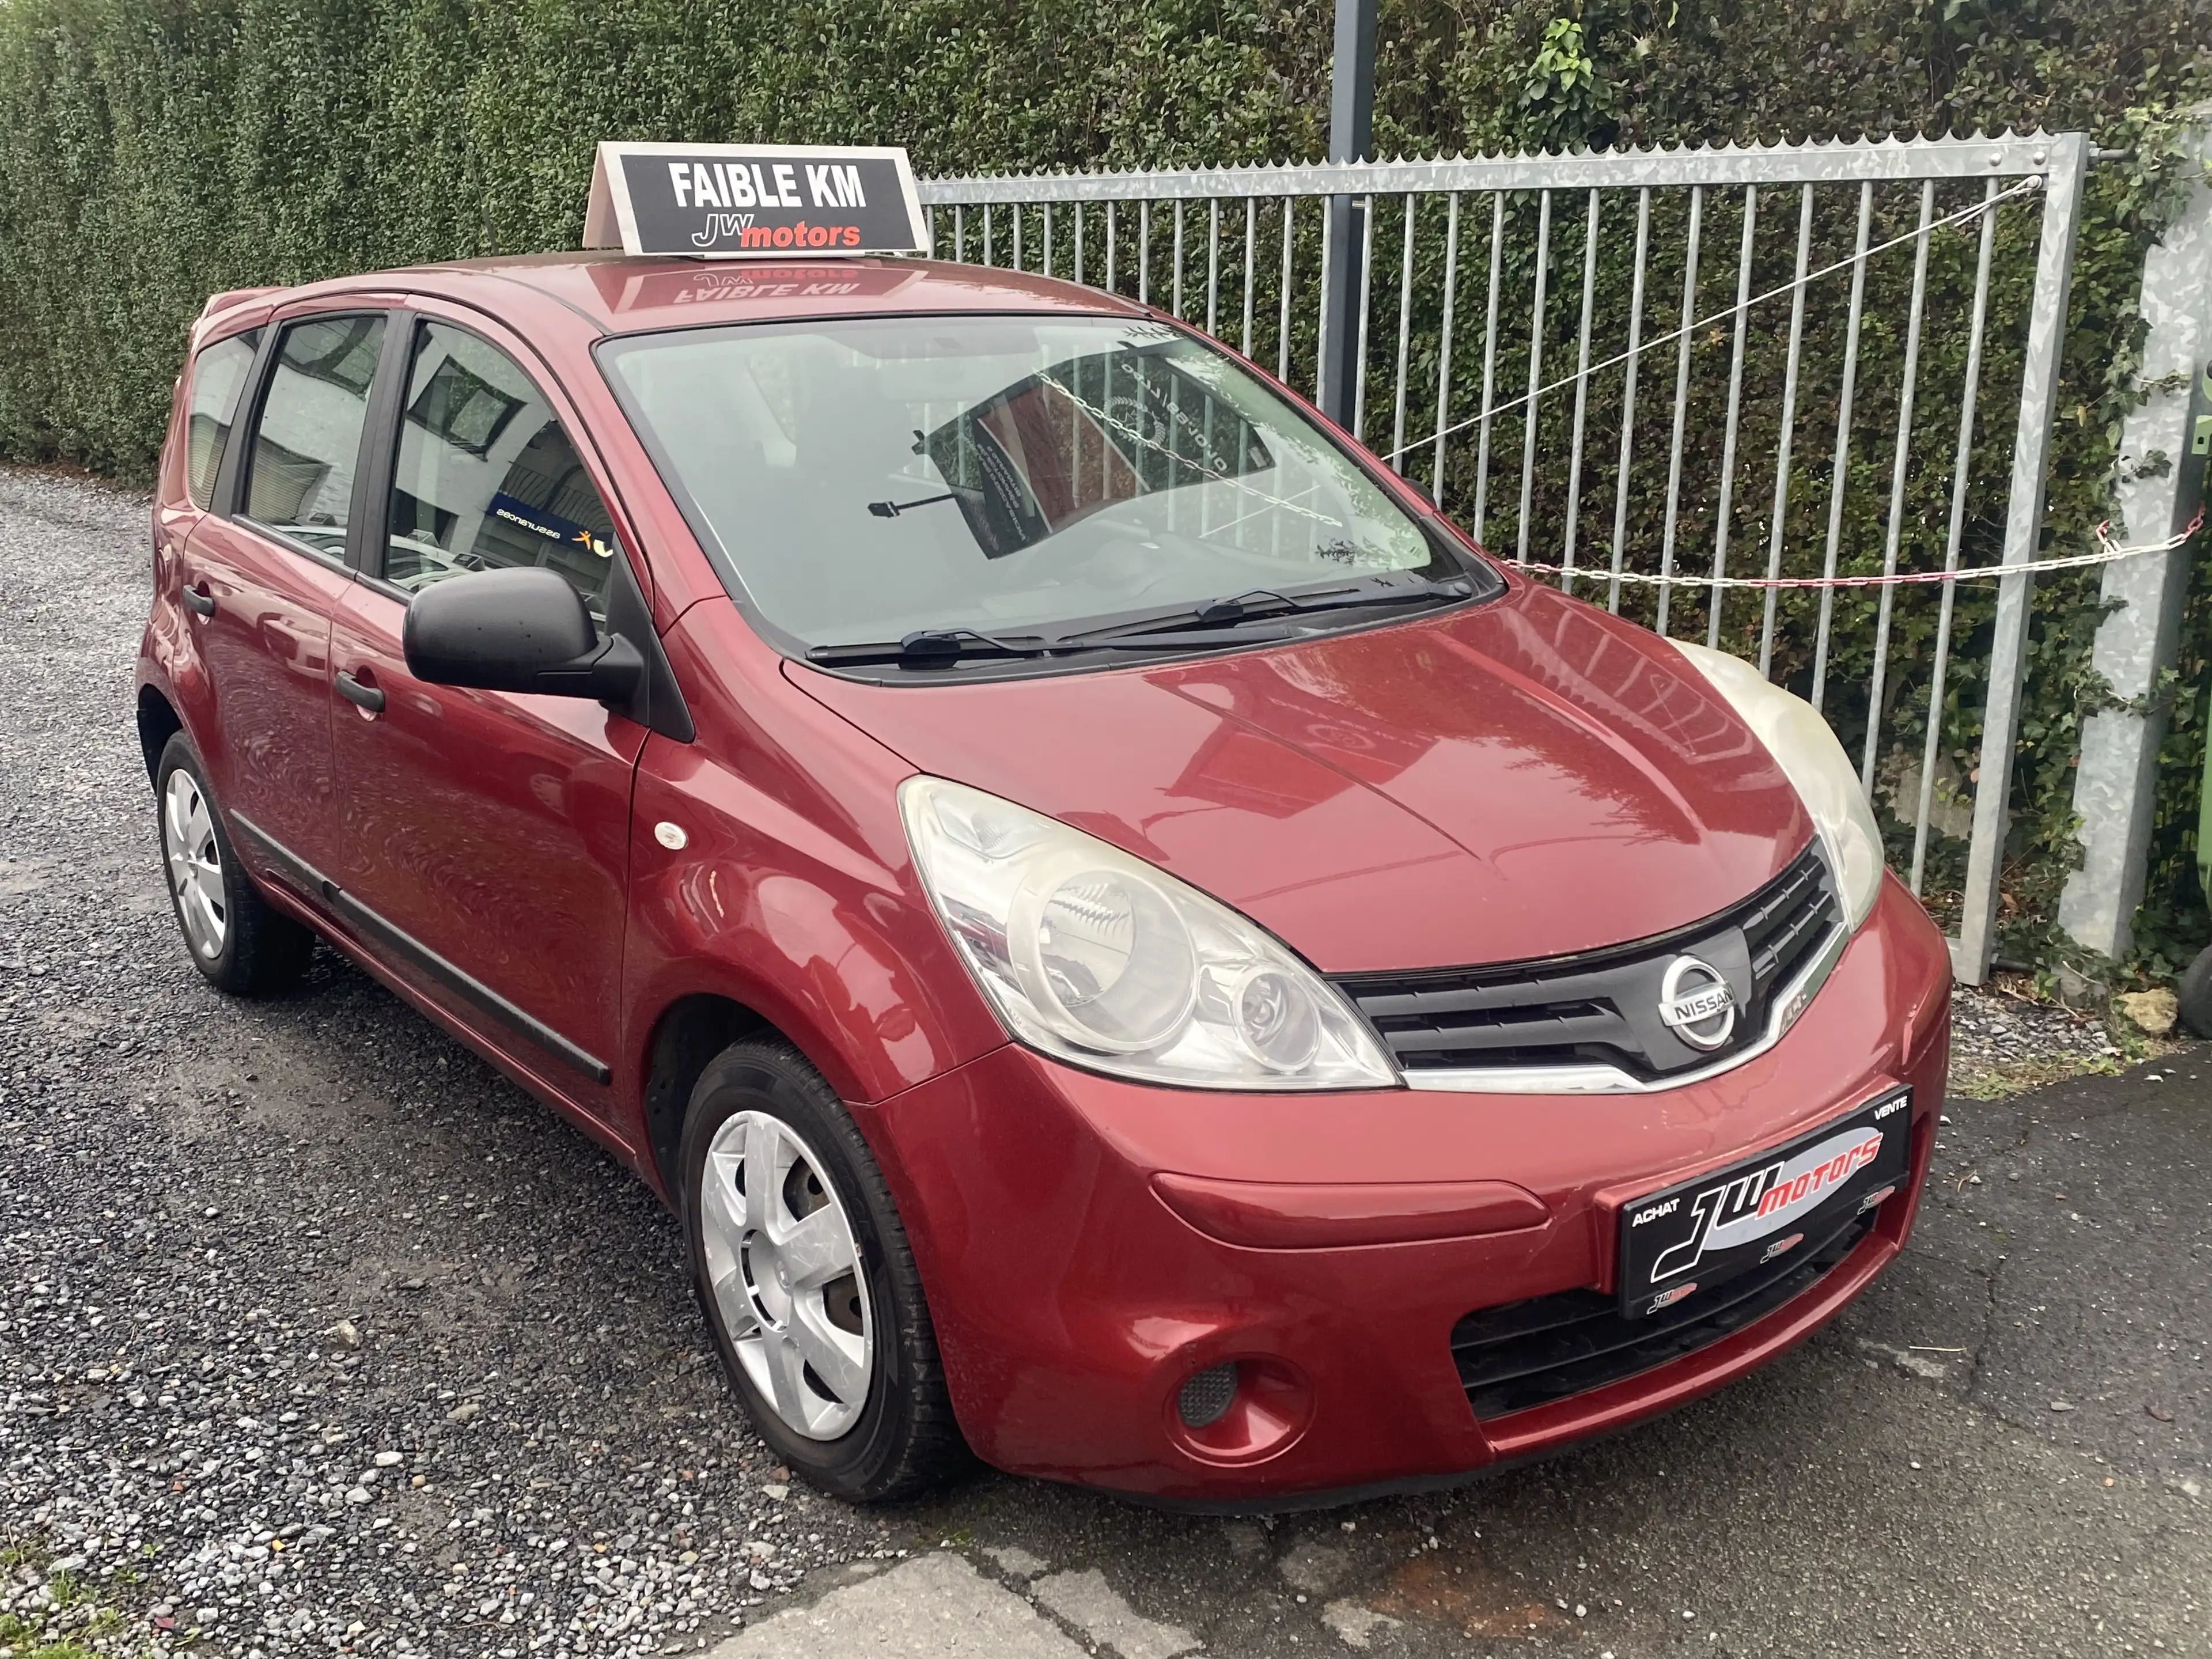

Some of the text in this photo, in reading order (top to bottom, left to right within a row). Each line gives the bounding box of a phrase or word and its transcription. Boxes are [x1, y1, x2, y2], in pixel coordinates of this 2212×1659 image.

[668, 162, 867, 207] FAIBLE KM
[691, 214, 861, 248] JW motors
[1673, 987, 1733, 1020] NISSAN
[1874, 1096, 1908, 1120] VENTE
[1631, 1198, 1680, 1228] ACHAT
[1650, 1161, 1785, 1283] JW
